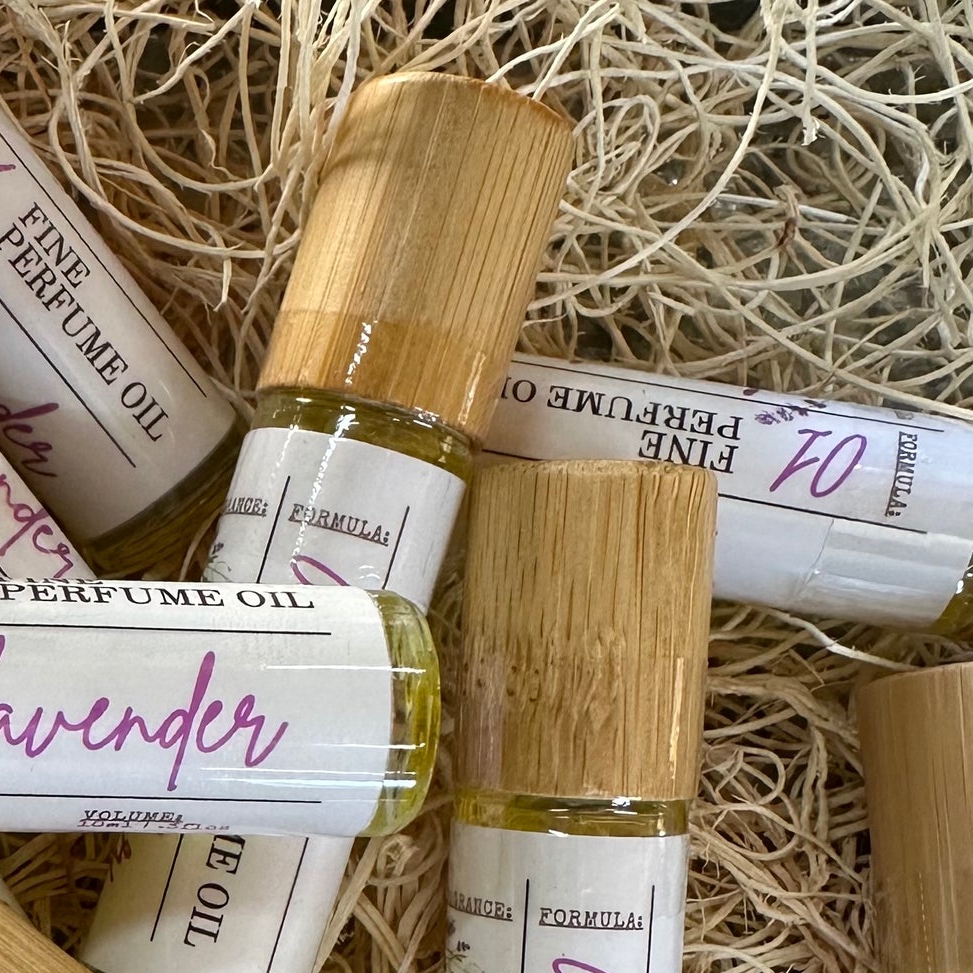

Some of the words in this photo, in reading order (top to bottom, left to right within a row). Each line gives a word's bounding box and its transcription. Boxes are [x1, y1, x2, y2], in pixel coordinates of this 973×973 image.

[18, 202, 91, 291] FINE
[120, 374, 171, 443] OIL
[501, 378, 537, 402] OI
[546, 385, 742, 440] PERFUME
[638, 429, 739, 474] FINE
[768, 428, 867, 498] 01
[885, 431, 919, 518] FORMULA:
[288, 503, 391, 547] FORMULA:
[0, 582, 224, 608] PERFUME
[236, 589, 315, 610] OIL
[184, 882, 230, 947] OIL
[539, 908, 644, 931] FORMULA:
